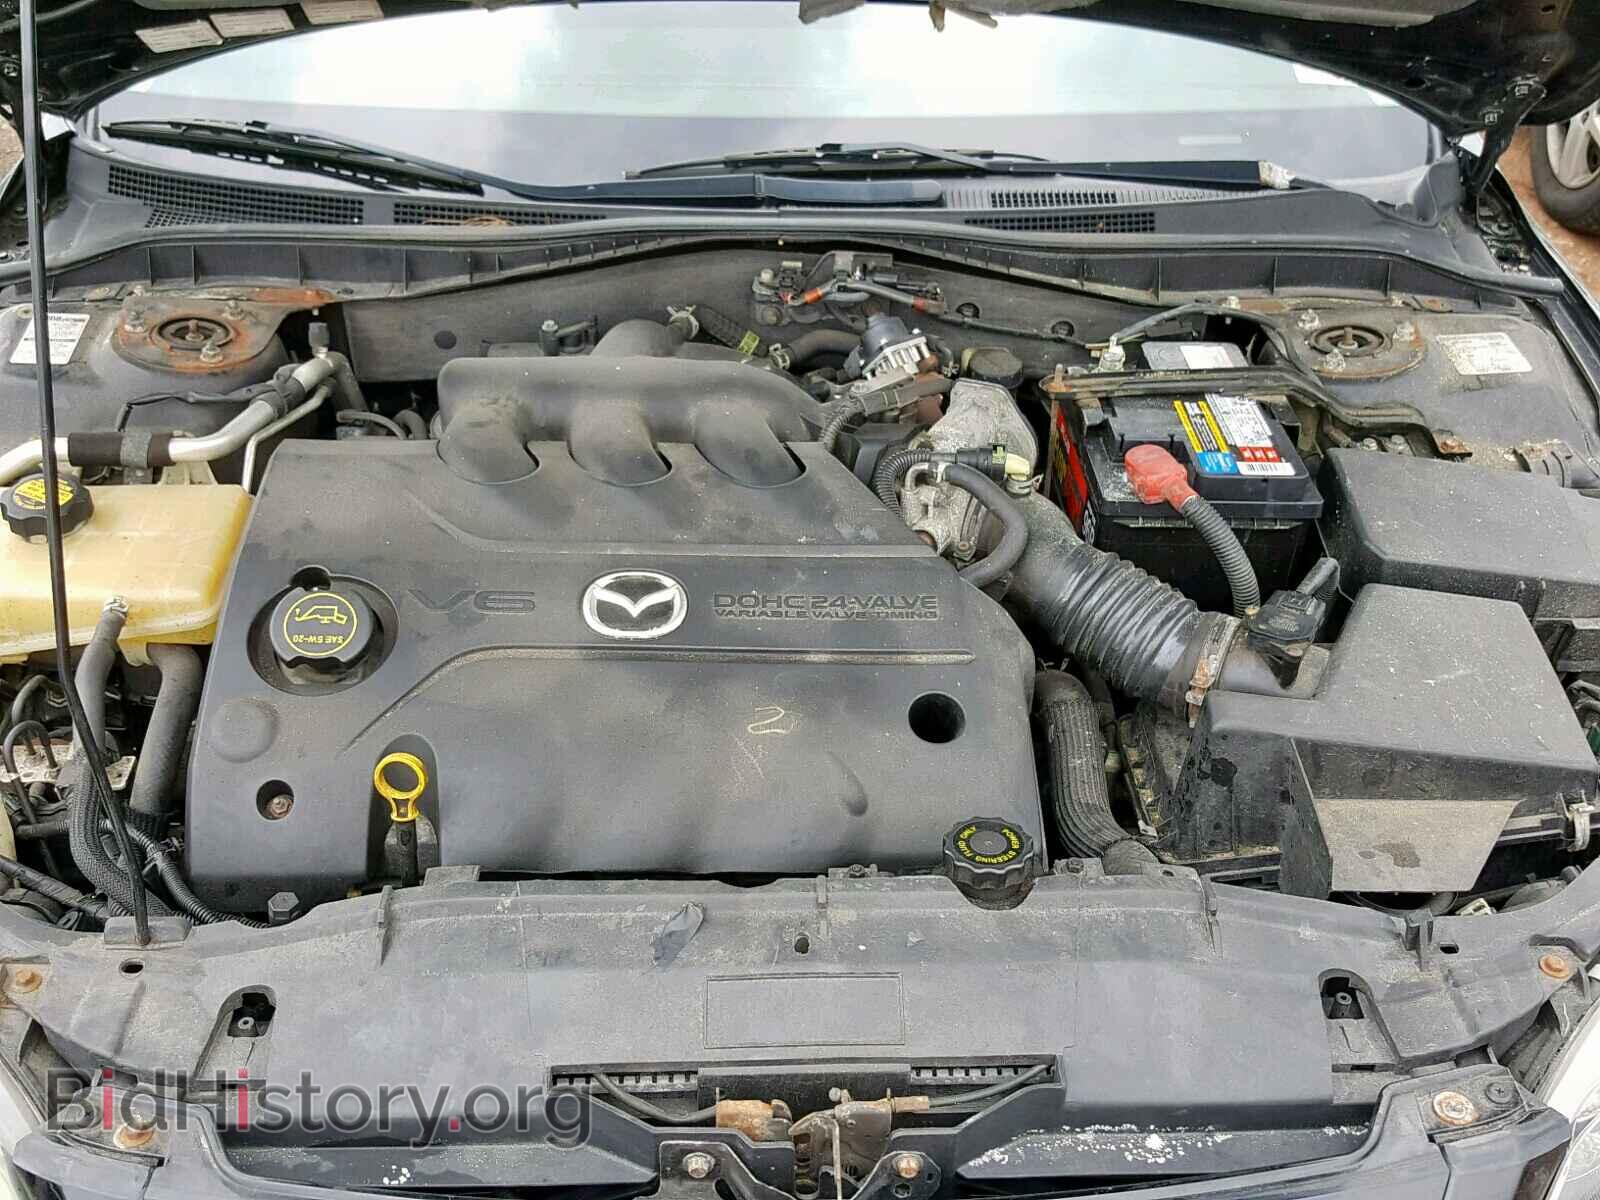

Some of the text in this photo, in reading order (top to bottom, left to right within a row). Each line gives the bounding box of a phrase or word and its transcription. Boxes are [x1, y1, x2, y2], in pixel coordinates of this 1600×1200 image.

[408, 590, 536, 613] V6
[713, 594, 804, 608] DOHC
[714, 609, 809, 618] VARIABLE
[292, 634, 344, 644] SAE 5W-20
[958, 825, 1020, 864] POWER STEERING FLUID ONLY
